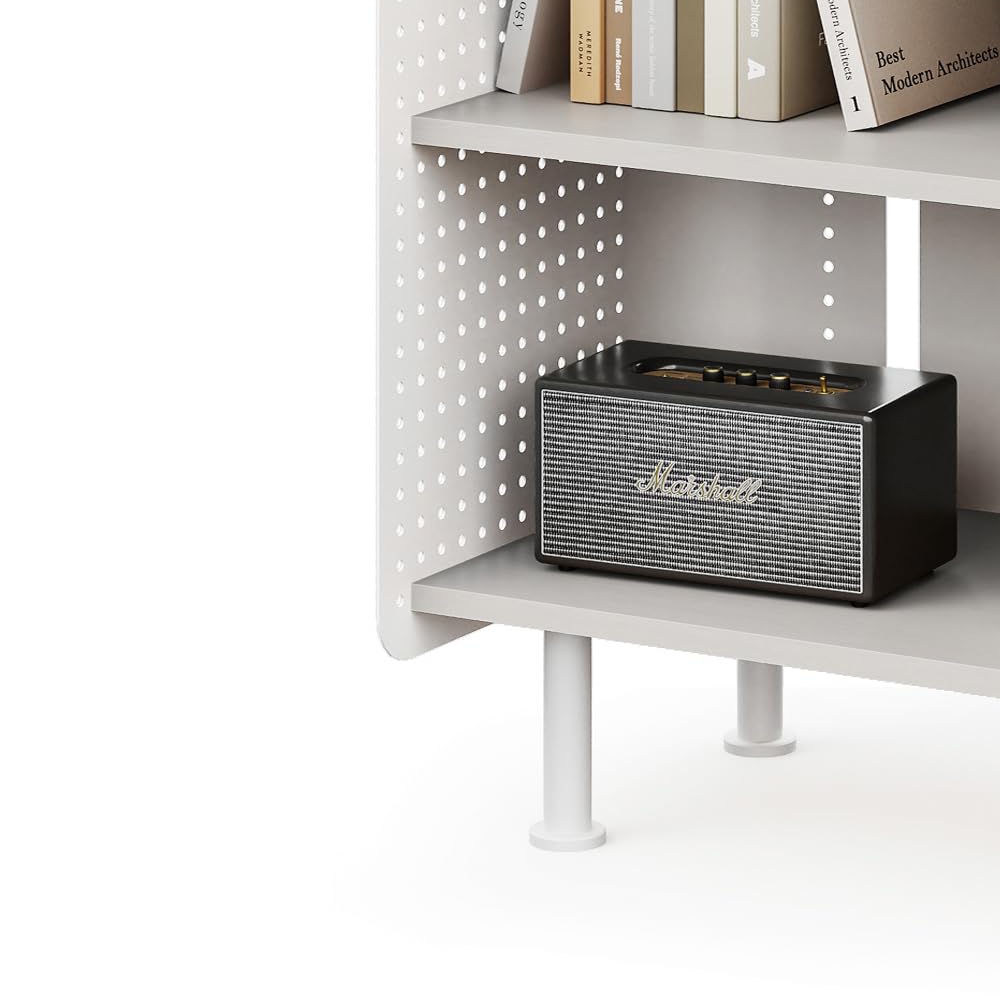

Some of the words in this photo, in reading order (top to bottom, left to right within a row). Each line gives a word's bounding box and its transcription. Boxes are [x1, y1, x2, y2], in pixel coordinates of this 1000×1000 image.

[747, 57, 766, 81] A
[835, 30, 852, 81] Architects
[876, 47, 906, 69] Best
[882, 70, 934, 96] Modern
[937, 44, 999, 77] Architects
[850, 96, 861, 112] 1
[636, 460, 762, 504] Marshall
